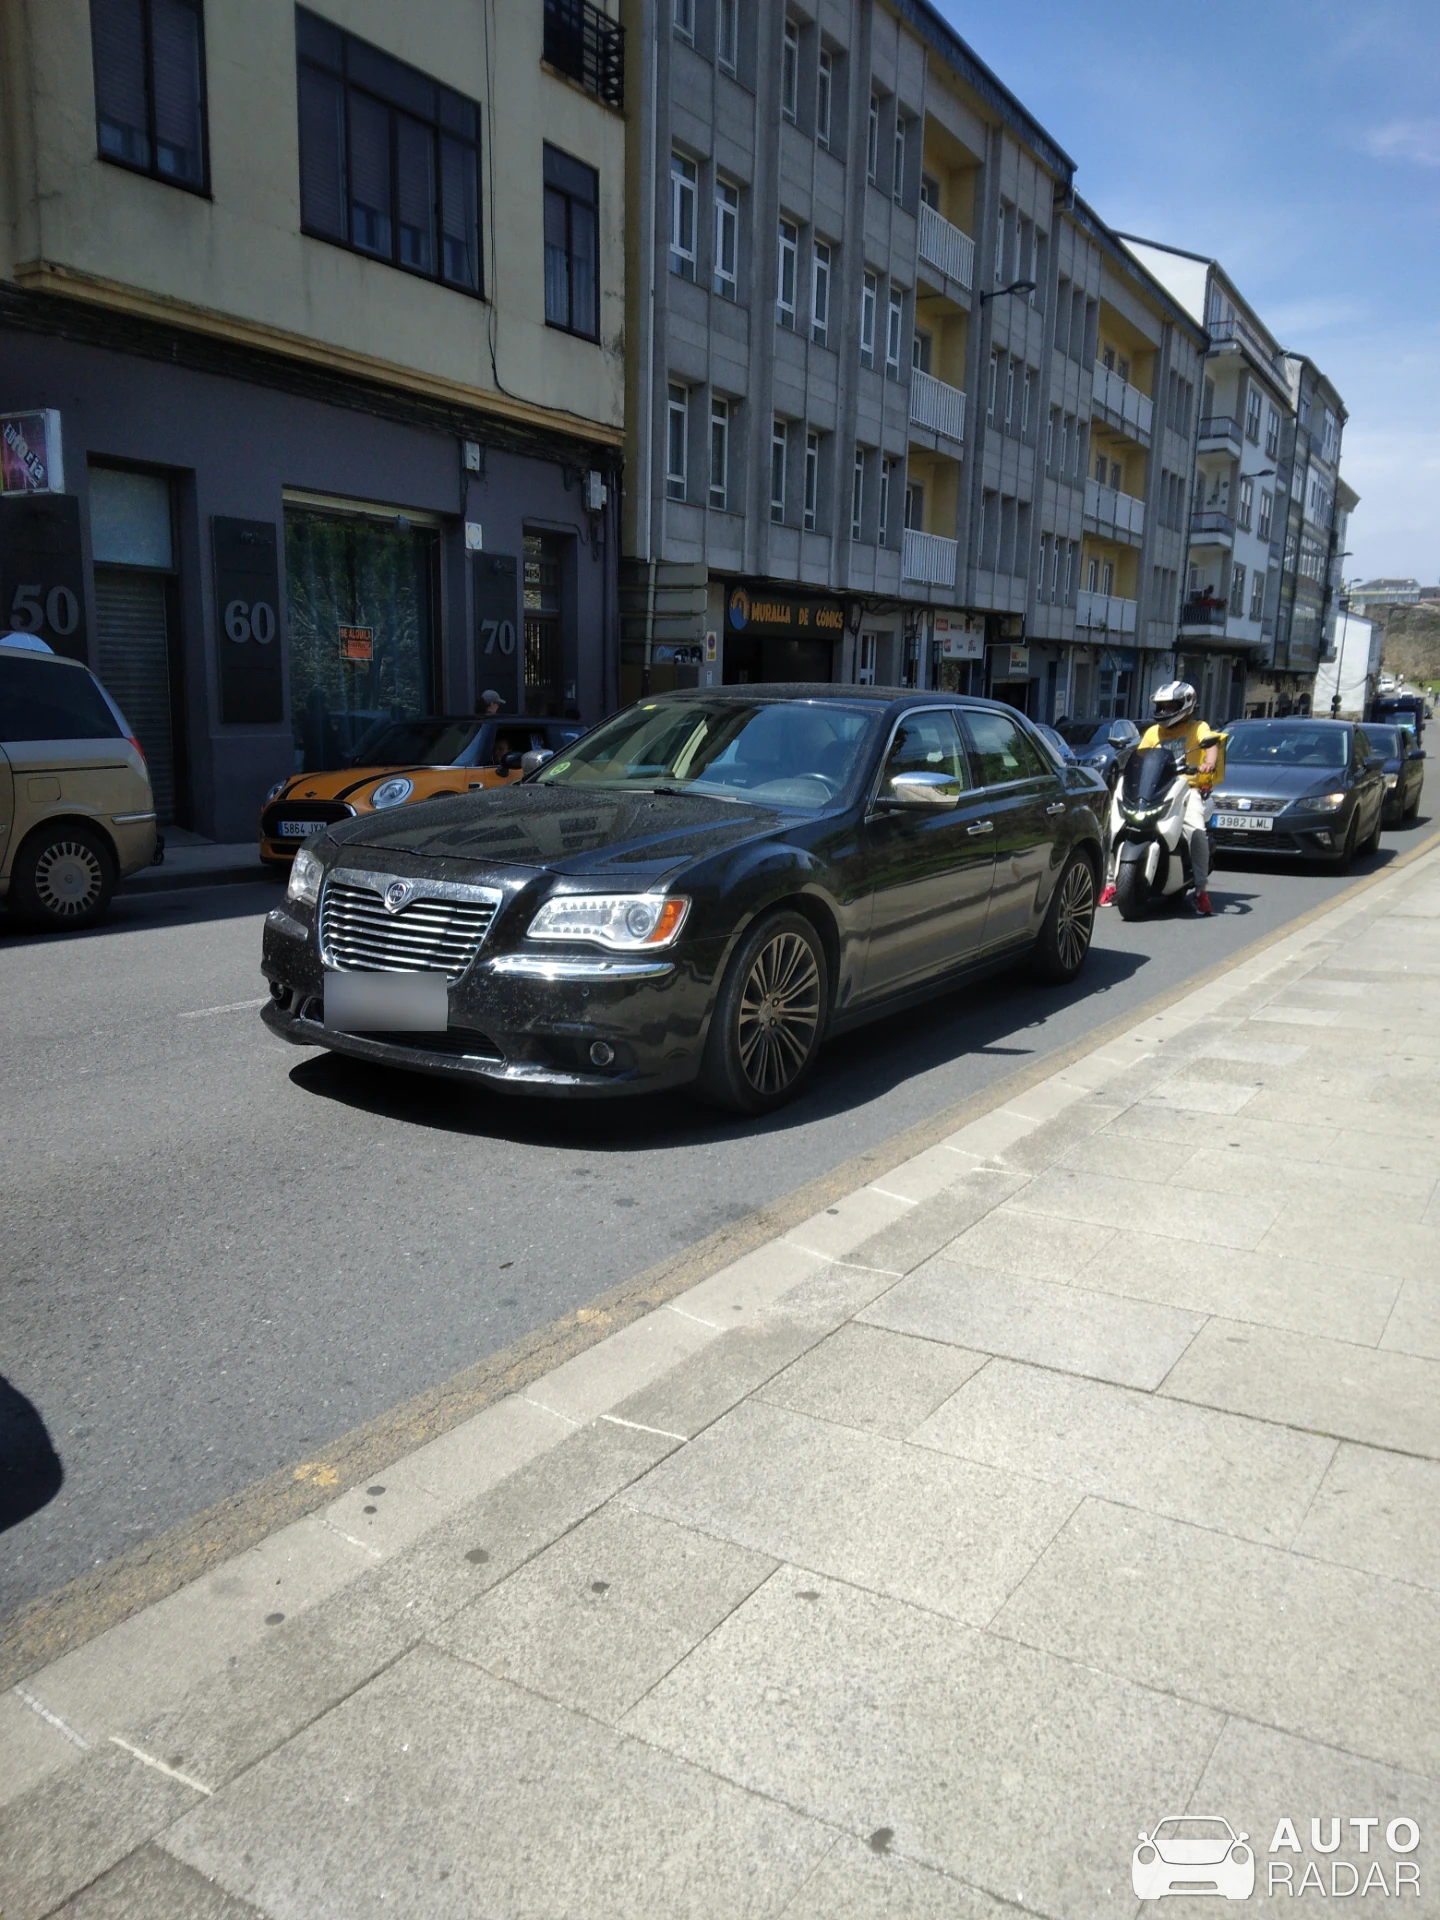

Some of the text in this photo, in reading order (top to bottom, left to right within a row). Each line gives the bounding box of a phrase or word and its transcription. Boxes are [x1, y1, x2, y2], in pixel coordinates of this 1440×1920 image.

[9, 584, 79, 635] 50
[224, 600, 276, 644] 60
[751, 602, 844, 629] MURALLA DE CÓMICS
[480, 619, 516, 655] 70
[284, 823, 305, 834] 5864
[1219, 816, 1270, 829] 3982 LML
